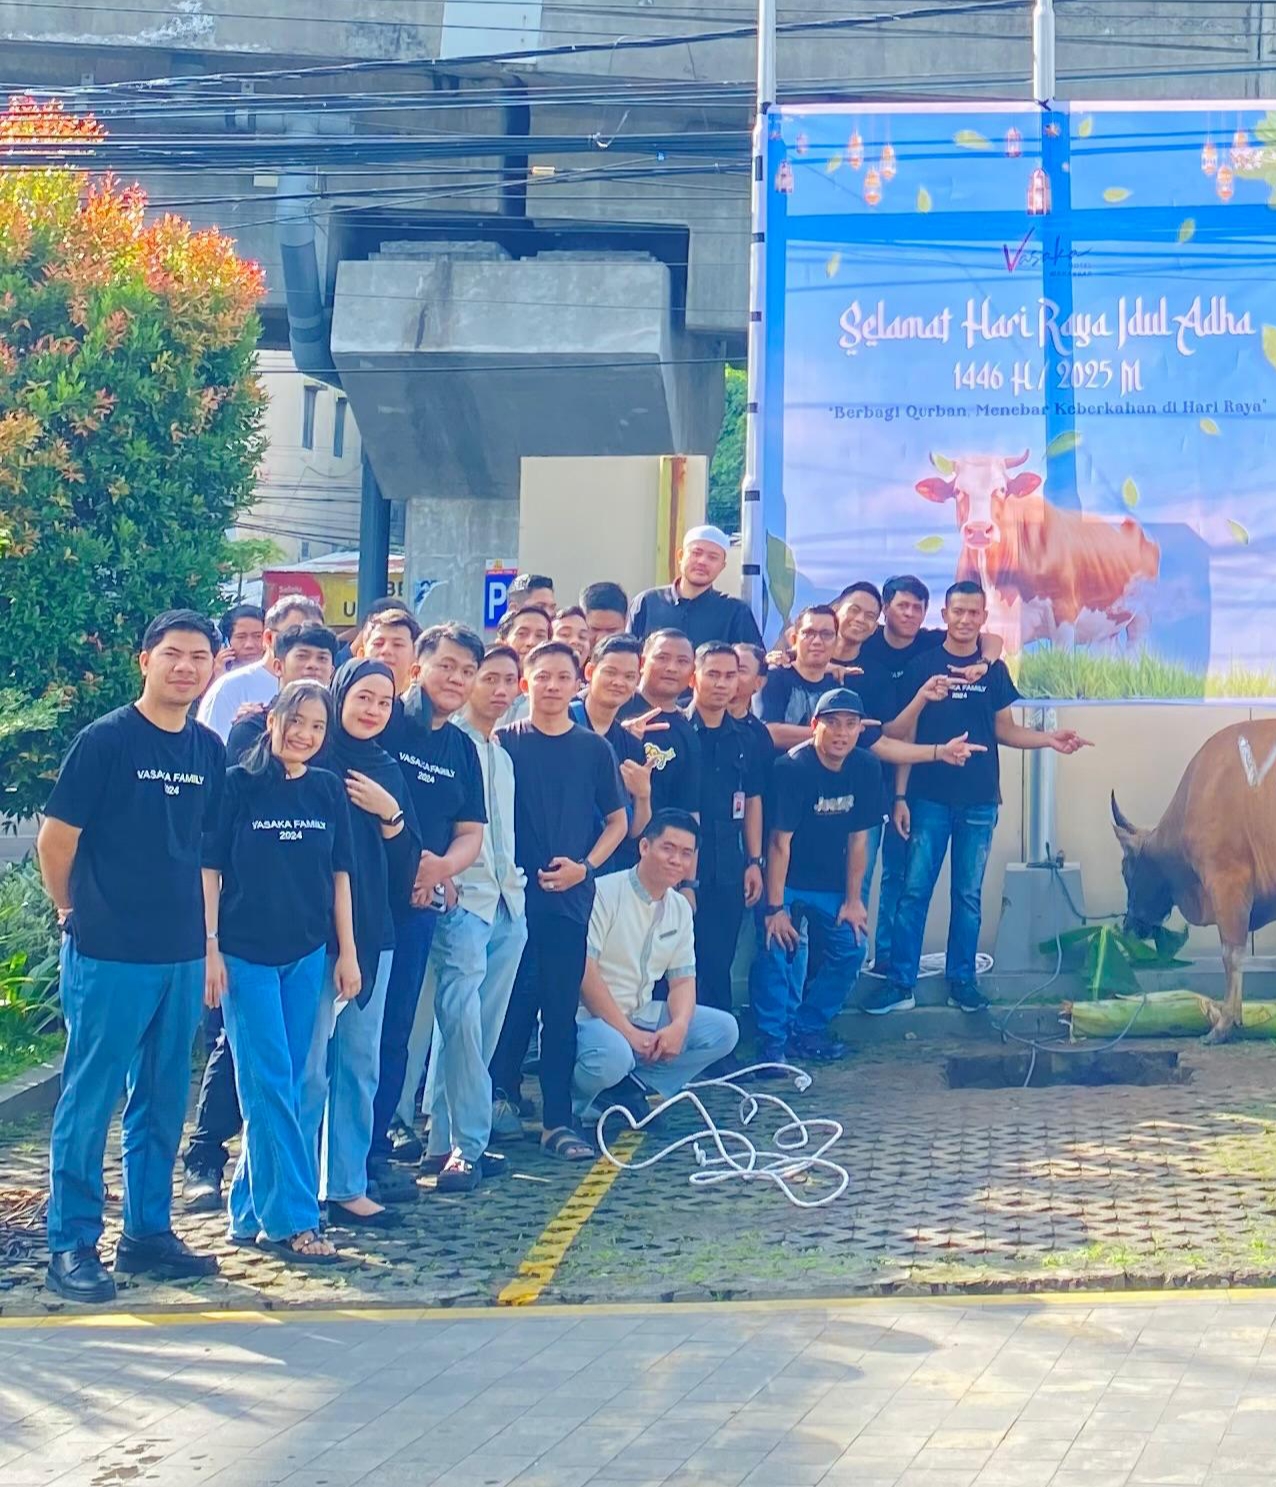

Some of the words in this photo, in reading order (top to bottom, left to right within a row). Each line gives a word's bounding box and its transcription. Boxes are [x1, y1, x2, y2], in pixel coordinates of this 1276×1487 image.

[839, 299, 954, 356] Selamat
[961, 296, 1034, 349] Hari
[1037, 297, 1113, 356] Raya
[1118, 296, 1172, 350] Idul
[1172, 296, 1256, 356] Adha
[954, 360, 1004, 390] 1446
[1011, 360, 1035, 396] H
[1057, 359, 1113, 389] 2025
[1120, 358, 1144, 398] M
[976, 403, 1049, 417] Menebar
[1054, 401, 1156, 415] Keberkahan
[1162, 401, 1177, 414] di
[1183, 400, 1218, 414] Hari
[488, 582, 507, 620] P
[137, 769, 171, 781] VASAKA
[173, 772, 204, 785] FAMILY
[252, 820, 293, 830] VASAKA
[294, 819, 326, 830] FAMILY
[279, 830, 303, 841] 2024
